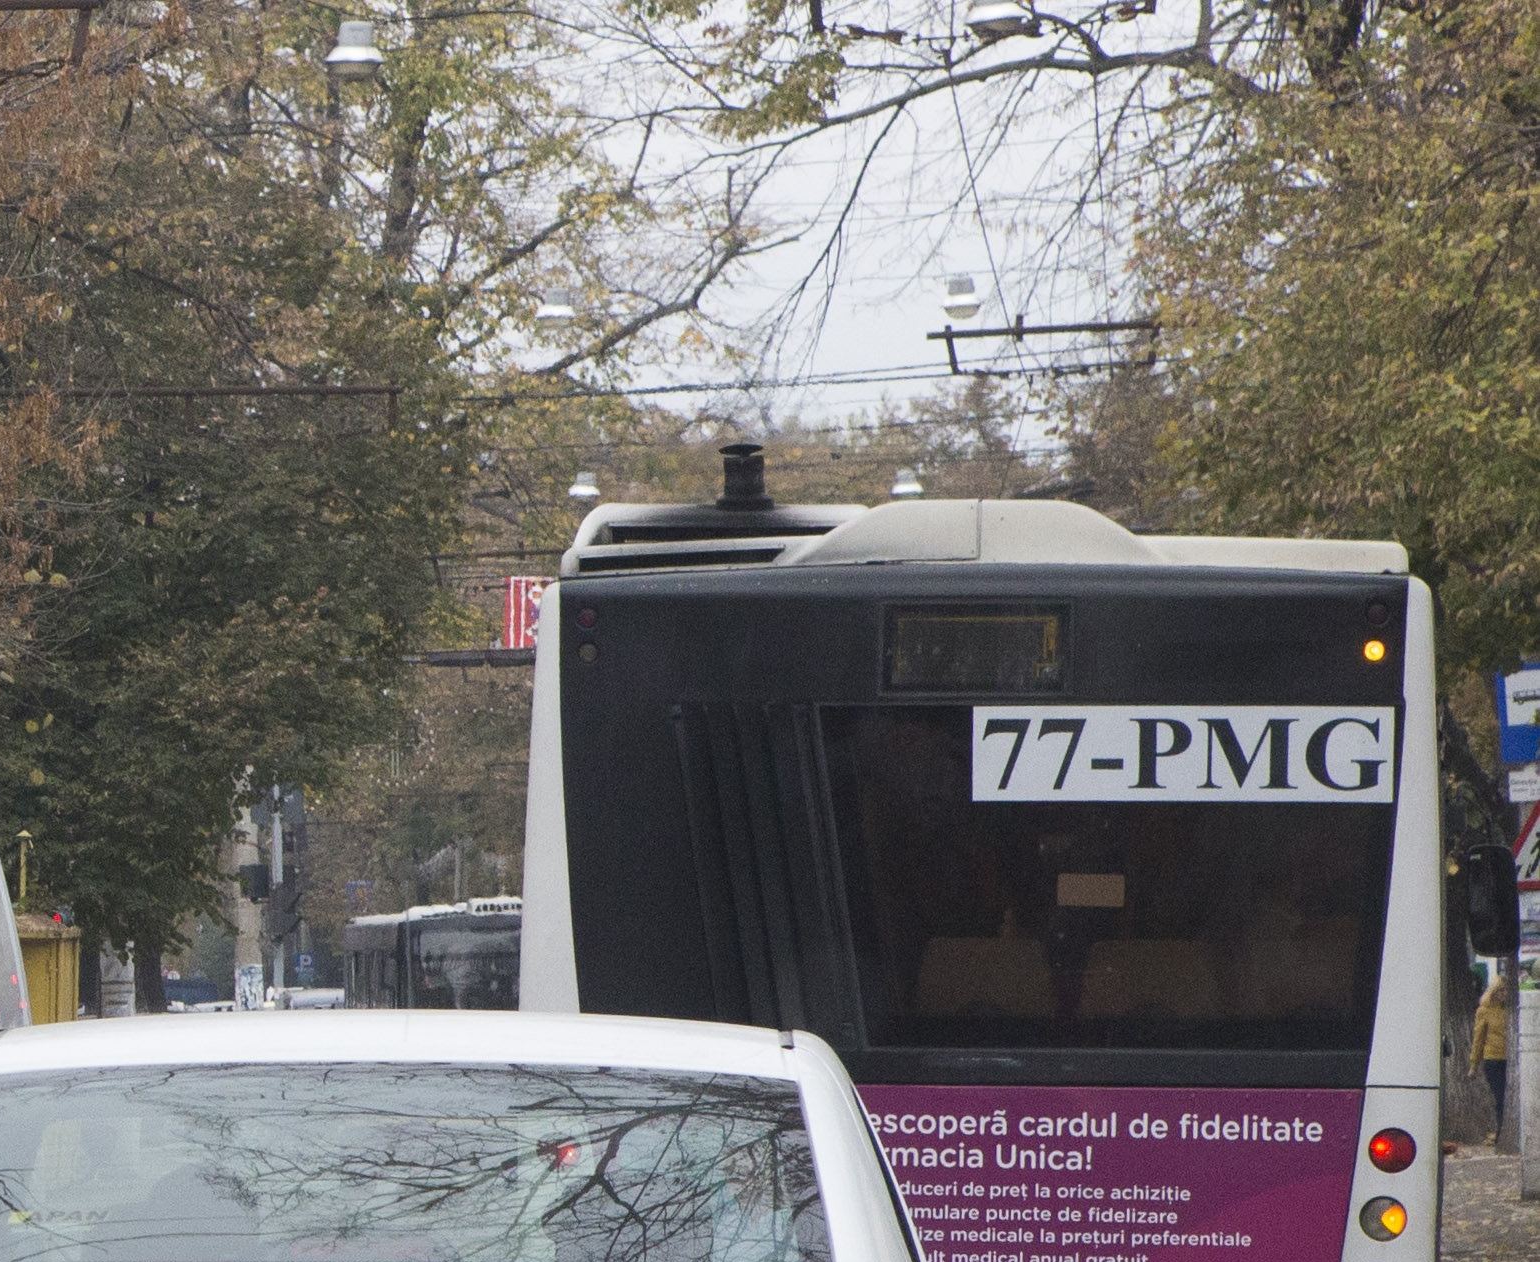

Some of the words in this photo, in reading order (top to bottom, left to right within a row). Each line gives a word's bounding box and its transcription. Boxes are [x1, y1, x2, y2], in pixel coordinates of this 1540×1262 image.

[981, 716, 1388, 792] 77-PMG
[1018, 1111, 1117, 1138] cardul
[1128, 1112, 1169, 1140] de
[1179, 1113, 1324, 1143] fidelitate
[884, 1141, 984, 1168] macia
[995, 1142, 1093, 1171] Unica!
[899, 1180, 958, 1197] duceri
[961, 1181, 985, 1198] de
[989, 1182, 1028, 1201] preț
[1035, 1182, 1051, 1199] la
[1056, 1183, 1105, 1200] orice
[985, 1206, 1052, 1223] puncte
[1057, 1206, 1082, 1223] de
[1087, 1207, 1179, 1225] fidelizare
[950, 1227, 1034, 1244] medicale
[1039, 1228, 1056, 1244] la
[1061, 1229, 1126, 1249] prețuri
[1131, 1230, 1253, 1248] preferentiale
